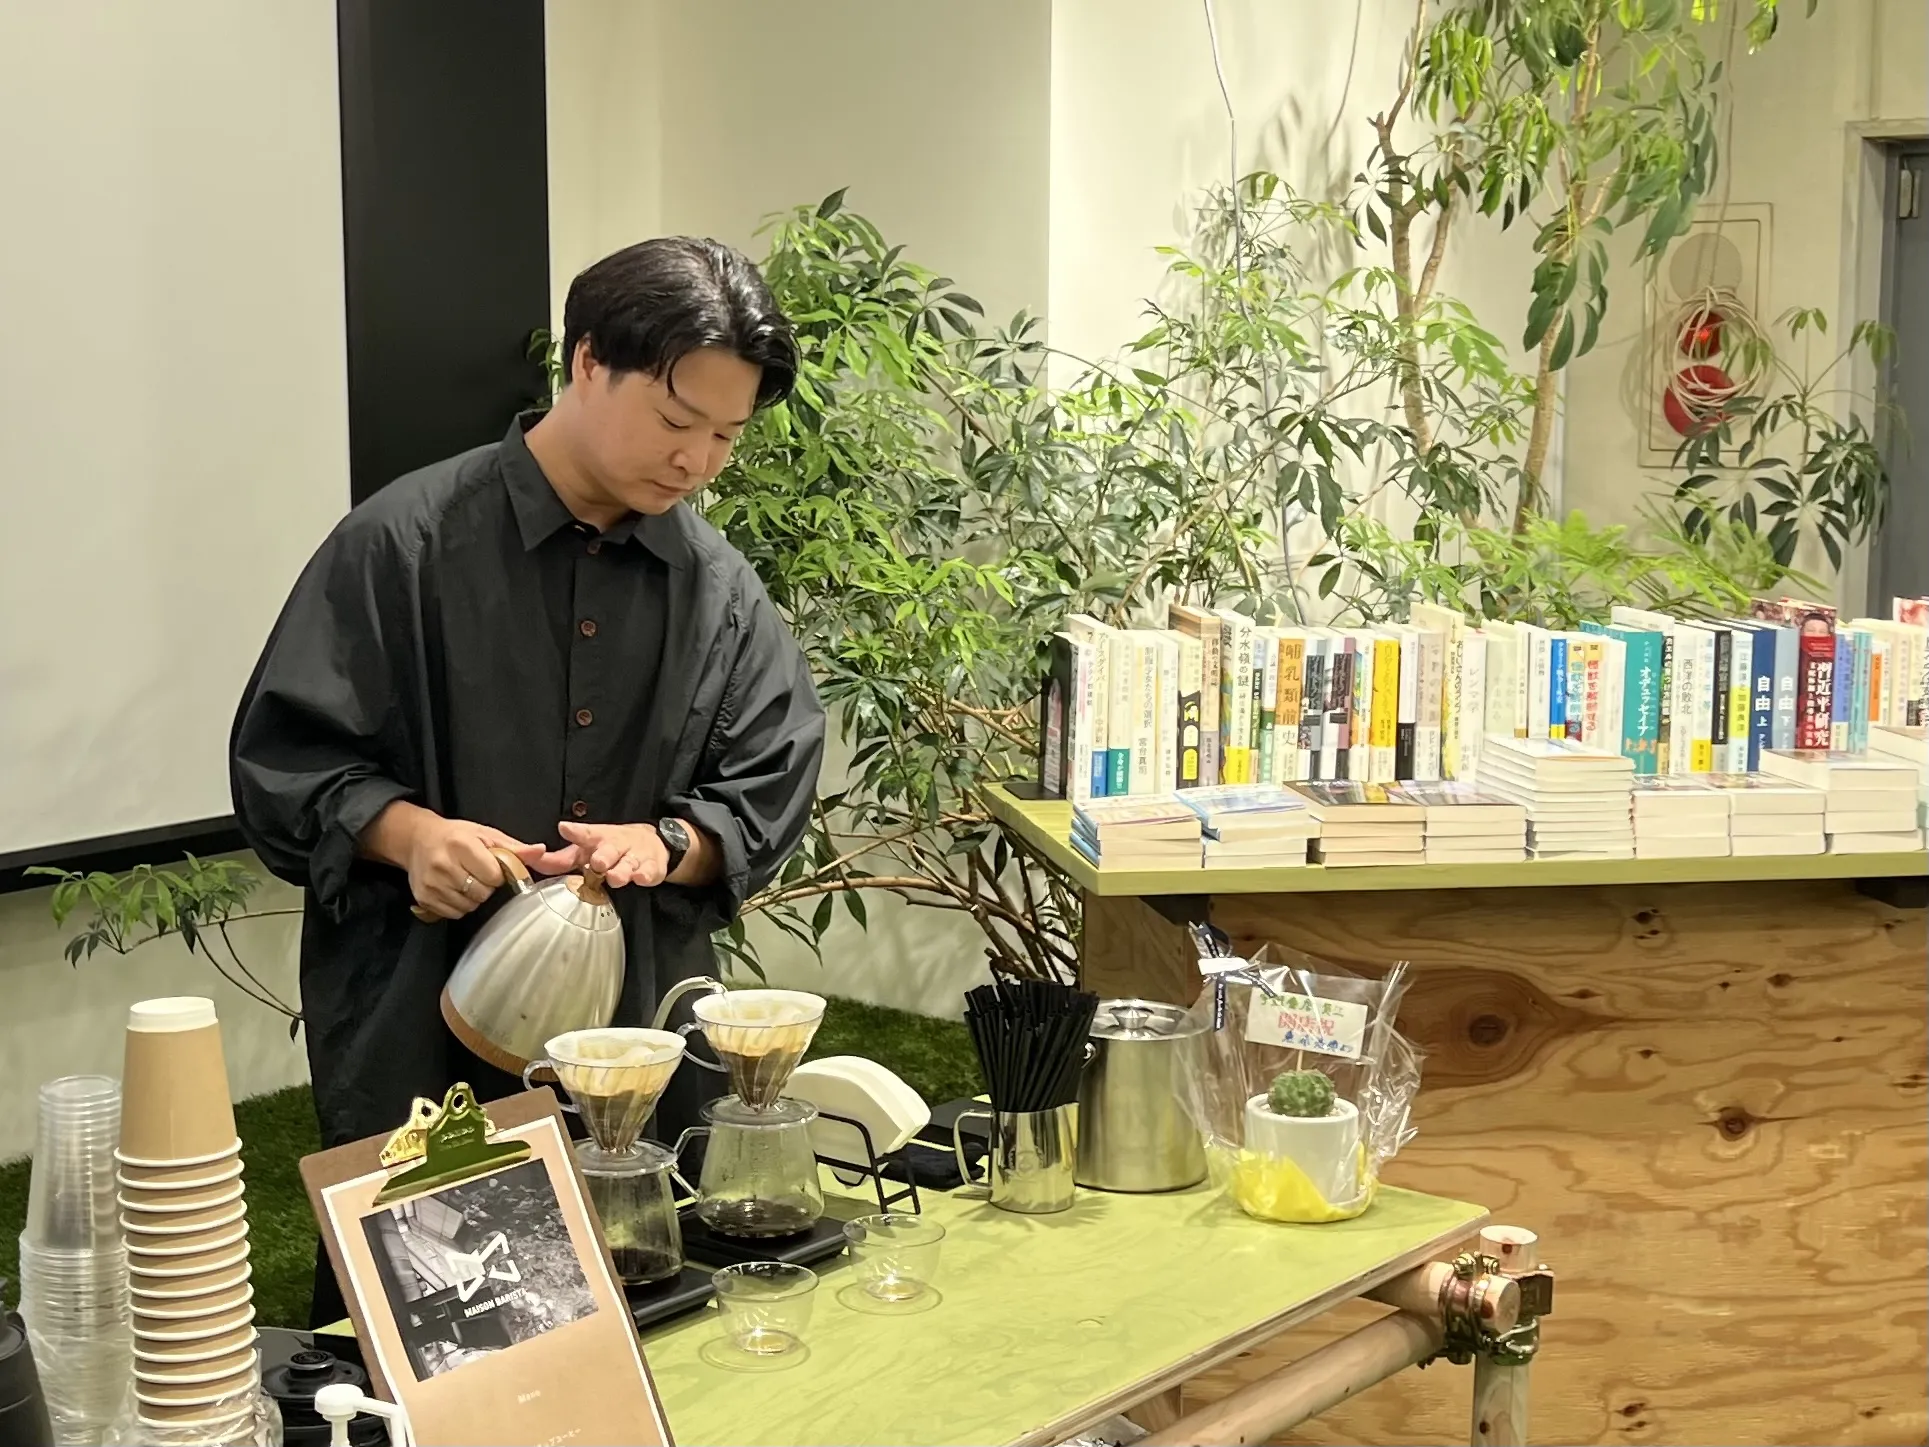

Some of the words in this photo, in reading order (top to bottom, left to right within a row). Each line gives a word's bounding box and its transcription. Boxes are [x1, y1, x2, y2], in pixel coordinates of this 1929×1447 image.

[1237, 626, 1252, 687] 分水嶺の謎
[1283, 643, 1302, 746] 哺乳類前史
[1681, 658, 1693, 715] 西洋の敗北
[1755, 675, 1771, 711] 自由
[1778, 675, 1794, 711] 自由
[1814, 662, 1832, 746] 習近平研究
[463, 1300, 496, 1318] MAISON
